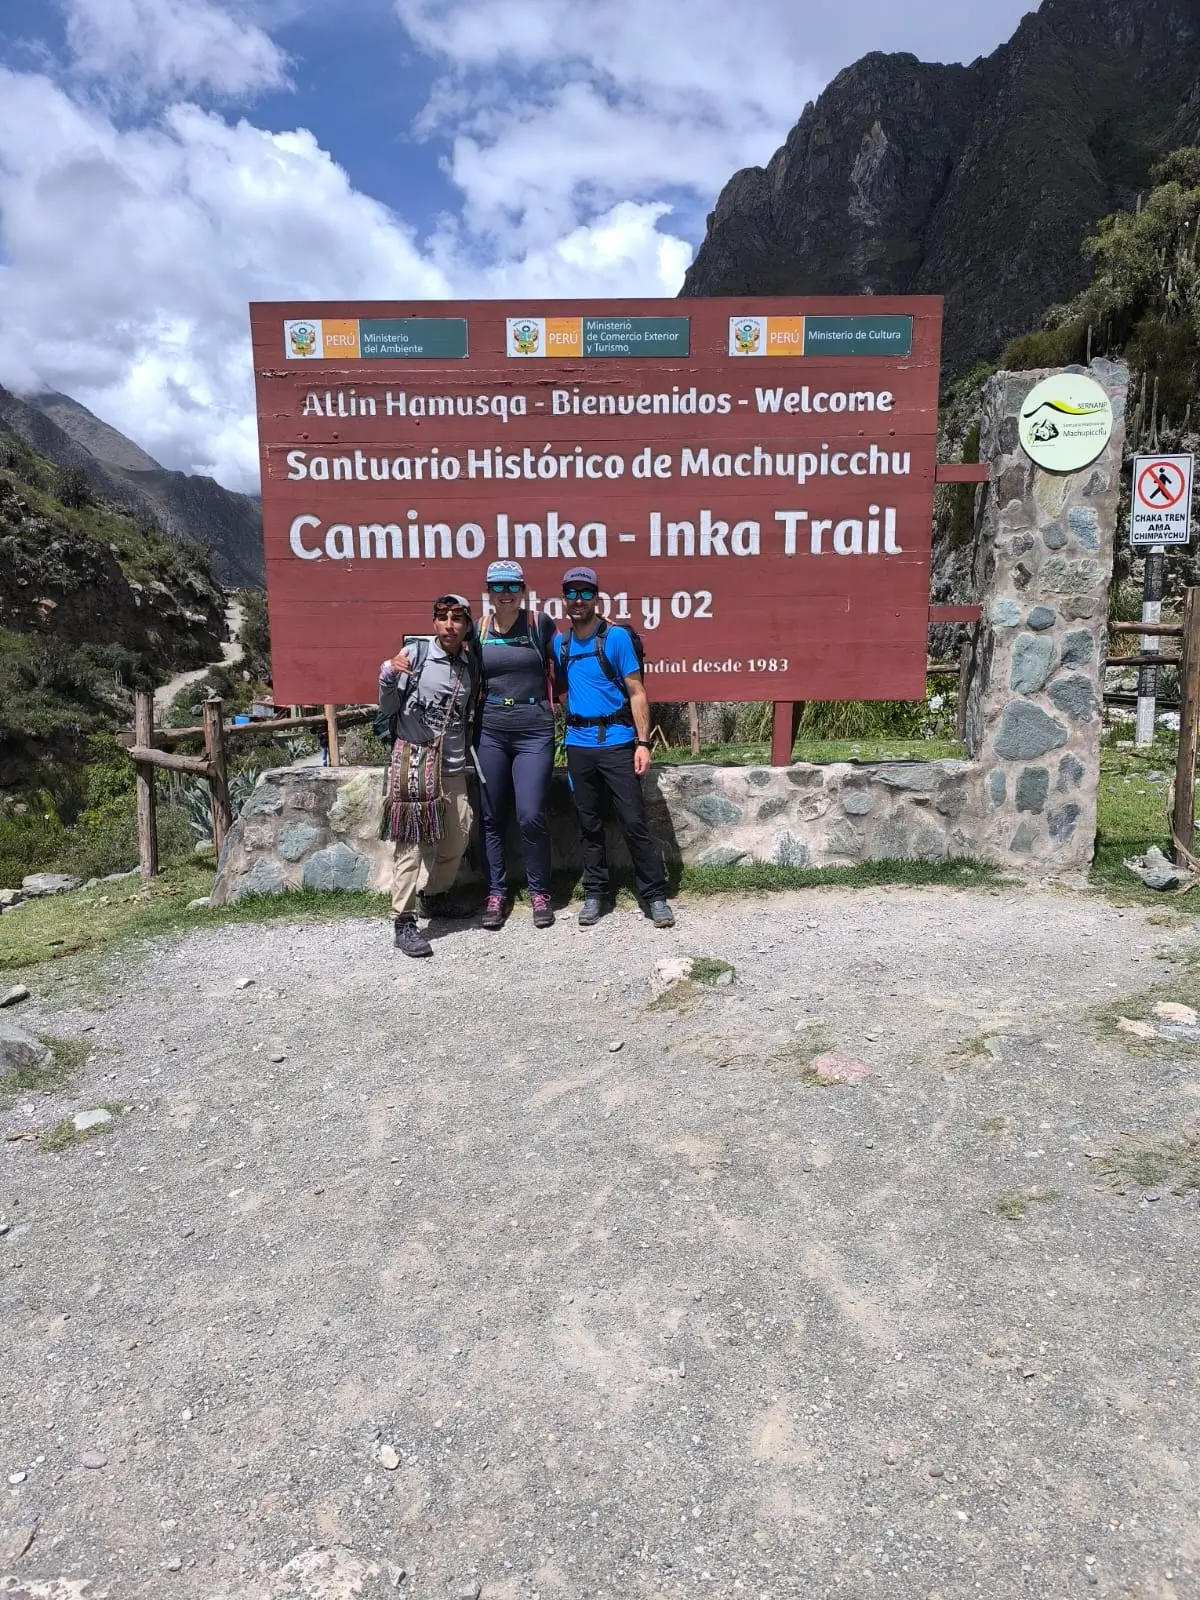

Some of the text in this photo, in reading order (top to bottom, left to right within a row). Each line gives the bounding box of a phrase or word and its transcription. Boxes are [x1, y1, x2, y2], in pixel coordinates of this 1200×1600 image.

[587, 321, 632, 330] Ministerio
[326, 332, 355, 346] PERÚ
[364, 333, 409, 343] Ministerio
[549, 330, 578, 345] PERÚ
[587, 332, 679, 341] de Comercio Exterior
[770, 329, 800, 344] PERÚ
[808, 330, 901, 340] Ministerio de Cultura
[364, 344, 423, 353] del Ambiente
[587, 342, 629, 353] y Turismo
[302, 389, 377, 418] Allin
[386, 391, 527, 422] Hamusqa
[552, 386, 732, 415] Bienvenidos
[754, 386, 894, 414] Welcome
[1062, 426, 1107, 437] Machupicchu
[286, 443, 911, 484] Santuario Histórico de Machupicchu
[1135, 513, 1186, 523] CHAKA TREN
[289, 509, 486, 561] Camino
[496, 511, 608, 559] Inka
[650, 509, 761, 557] Inka
[774, 503, 903, 556] Trail
[1134, 533, 1185, 541] CHIMPAYCHU
[596, 591, 631, 619] 01
[641, 595, 661, 630] y
[671, 590, 713, 619] 02
[643, 657, 789, 674] ndial desde 1983
